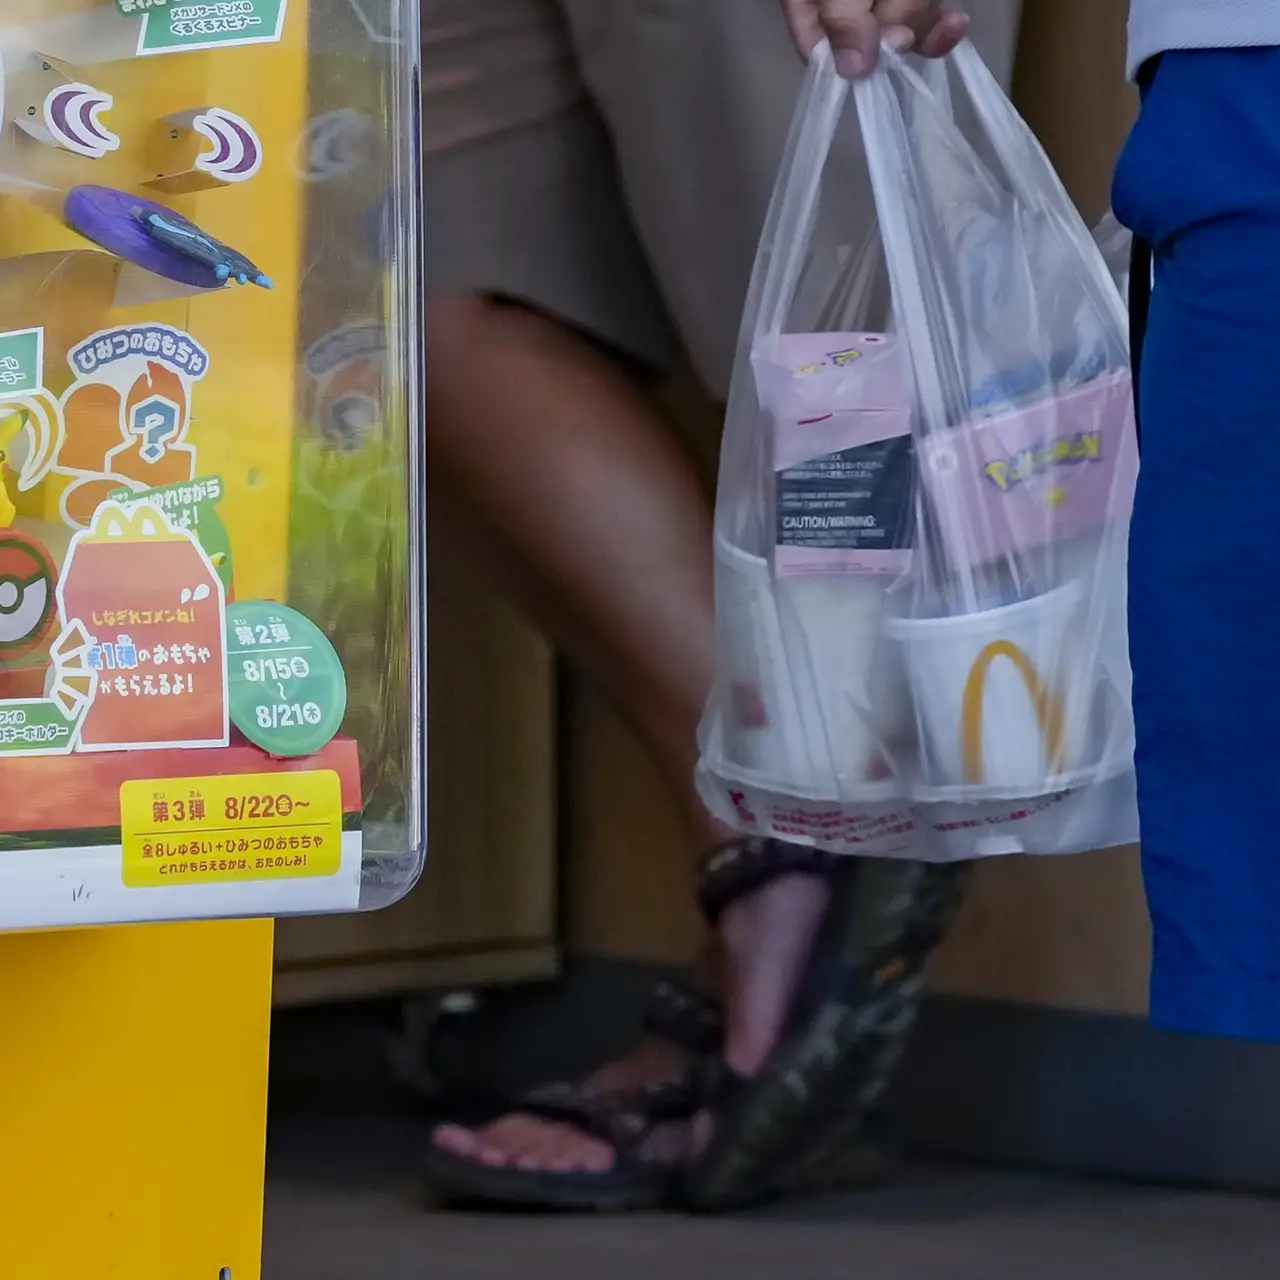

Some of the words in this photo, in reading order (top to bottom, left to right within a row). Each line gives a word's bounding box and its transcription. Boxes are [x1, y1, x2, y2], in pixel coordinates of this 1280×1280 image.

[77, 331, 203, 372] ひみつのおもちゃ
[235, 622, 290, 647] 第2弾
[99, 672, 194, 697] がもらえるよ!
[151, 798, 206, 823] 第3弾
